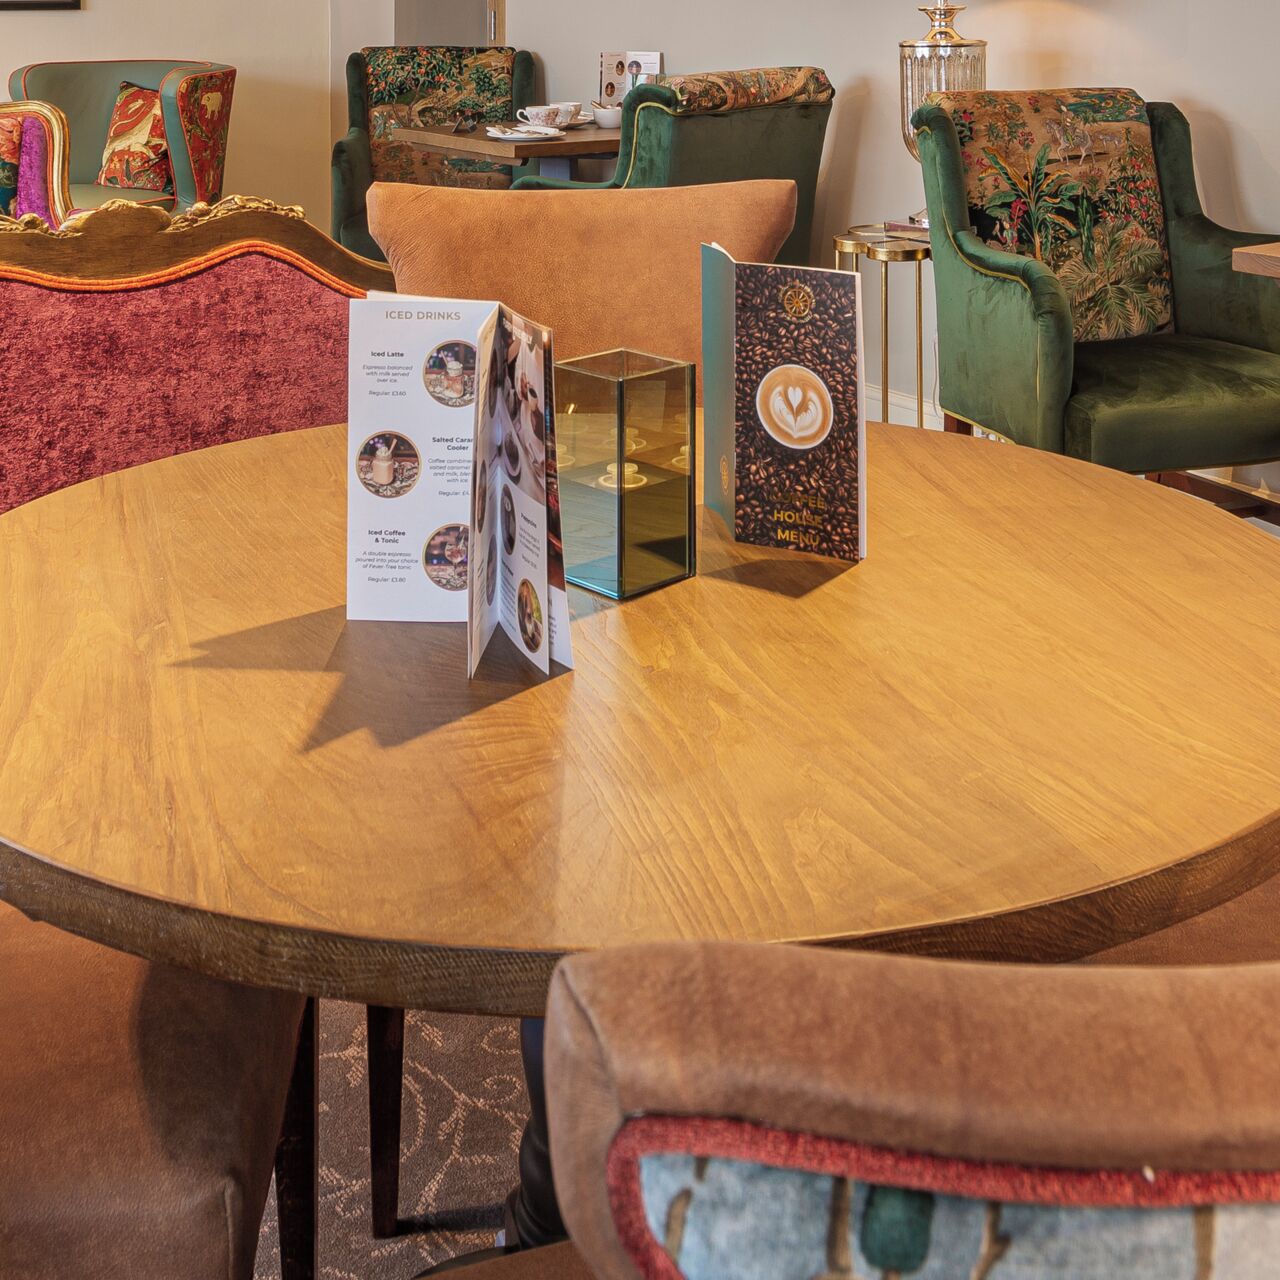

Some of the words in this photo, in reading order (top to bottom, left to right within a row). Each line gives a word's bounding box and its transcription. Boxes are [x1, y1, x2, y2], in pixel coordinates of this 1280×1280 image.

[385, 311, 413, 320] ICED
[416, 311, 461, 321] DRINKS
[774, 509, 823, 528] HOUSE
[777, 528, 821, 546] MENU
